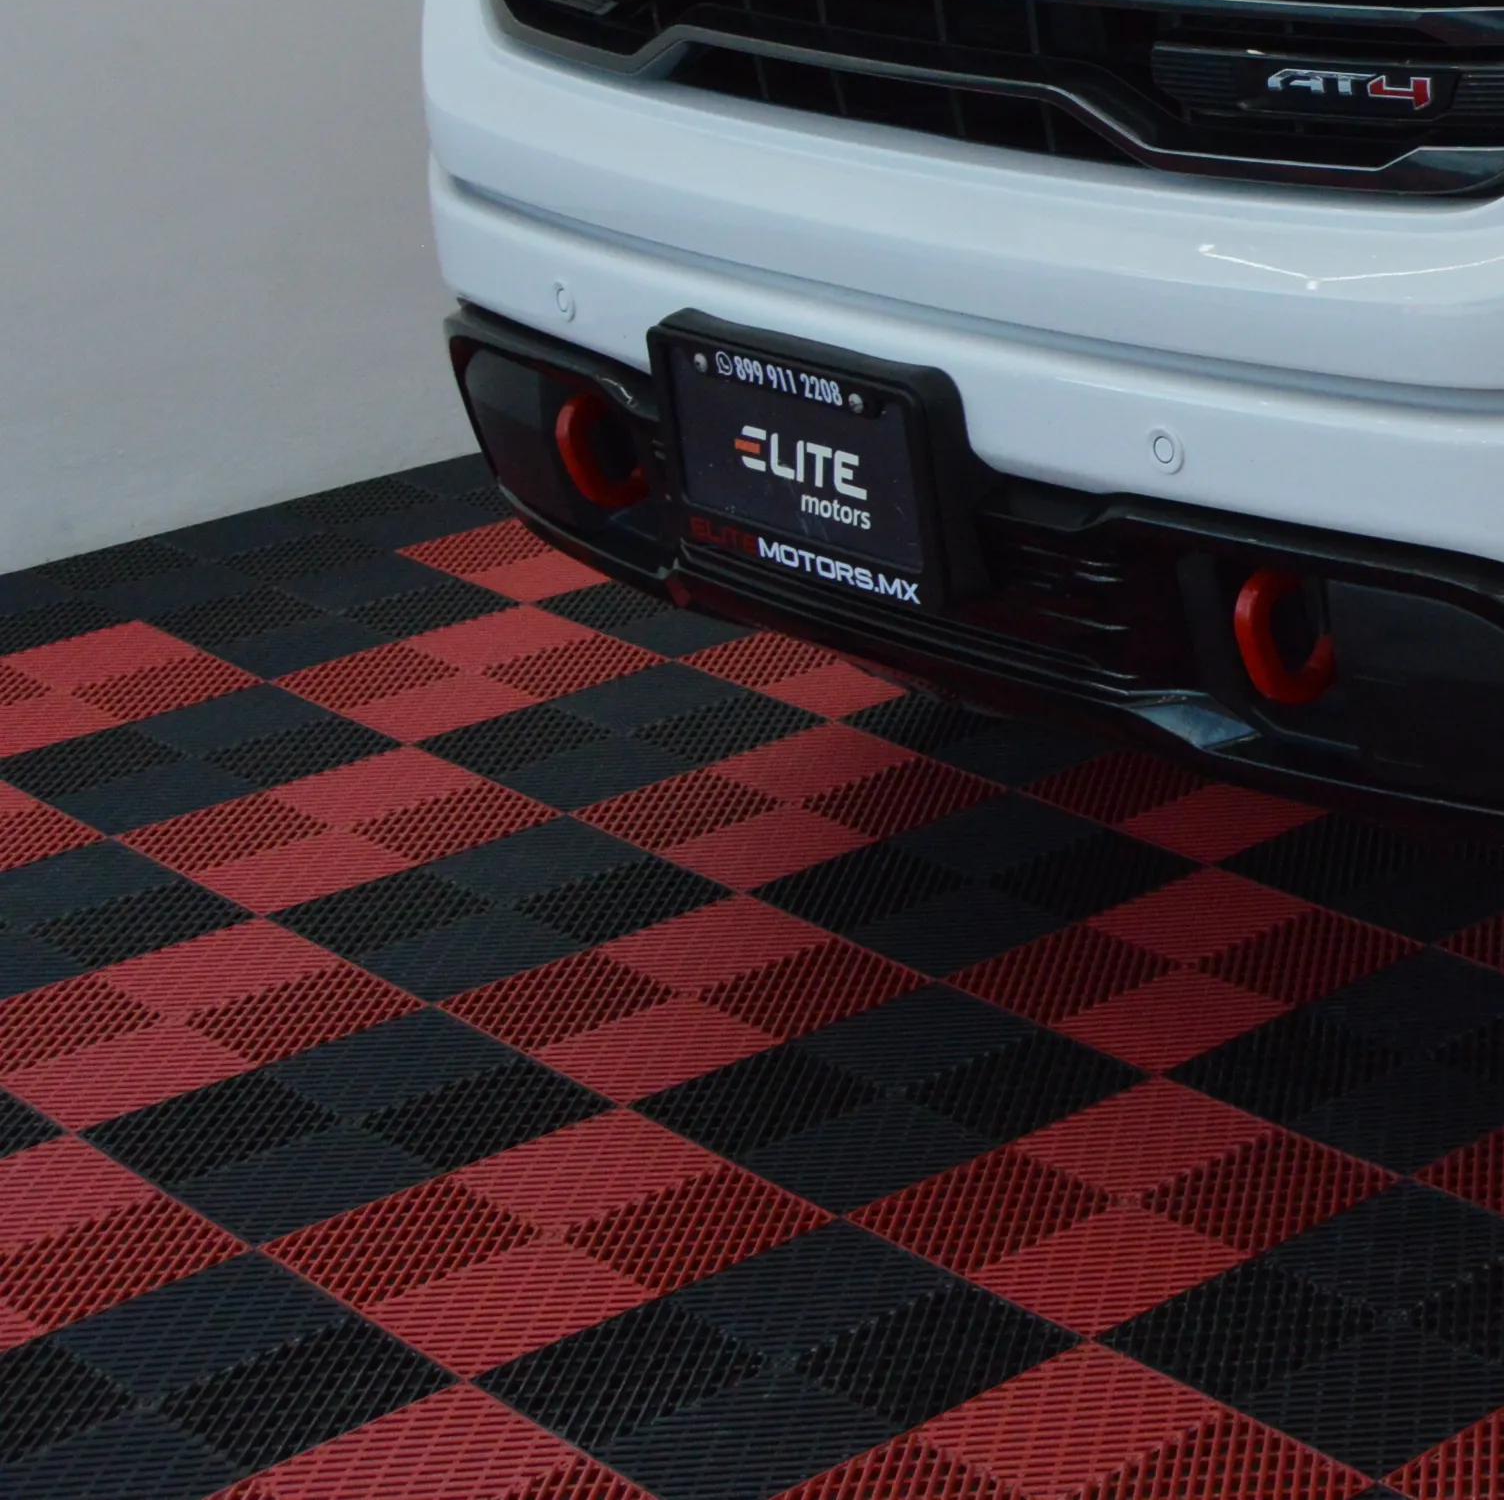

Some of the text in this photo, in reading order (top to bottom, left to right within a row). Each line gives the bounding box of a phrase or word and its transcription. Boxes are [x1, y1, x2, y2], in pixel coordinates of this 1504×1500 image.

[1267, 68, 1432, 110] AT4
[734, 355, 843, 406] 899 911 2208
[734, 424, 868, 500] ELITE
[801, 494, 872, 530] motors
